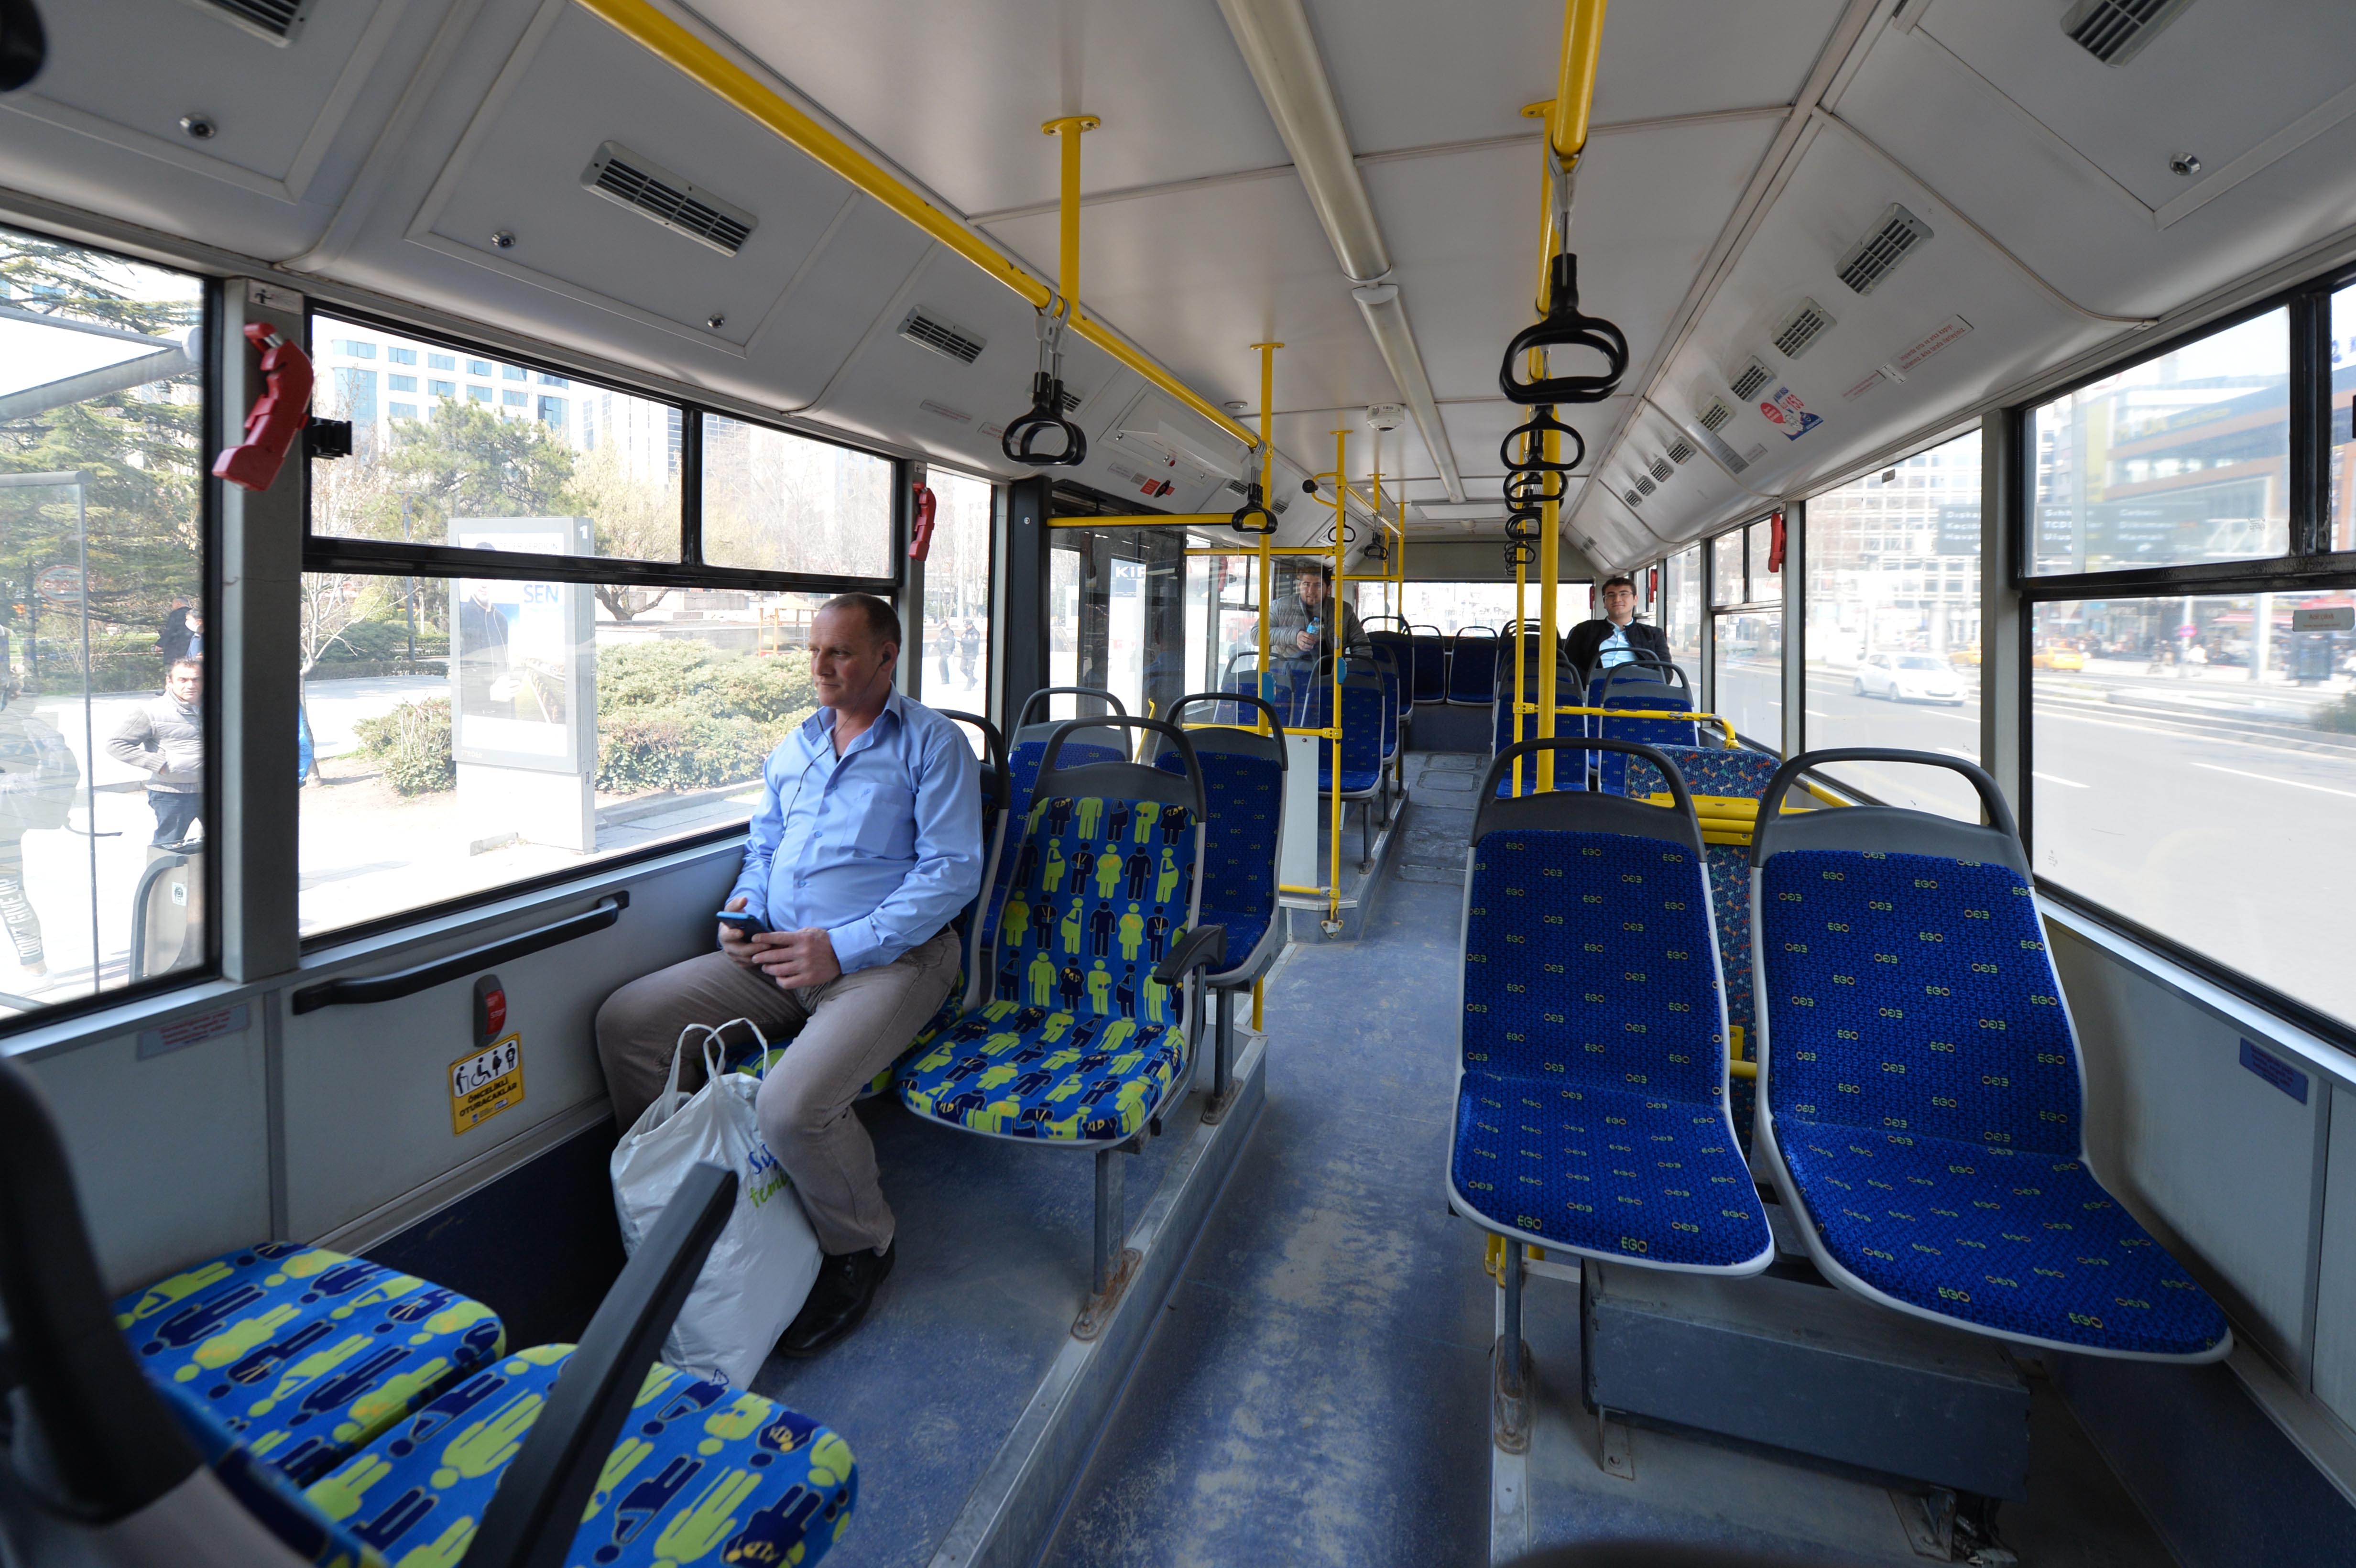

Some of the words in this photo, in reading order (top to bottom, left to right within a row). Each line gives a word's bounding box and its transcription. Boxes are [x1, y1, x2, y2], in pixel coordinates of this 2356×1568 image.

[579, 525, 588, 539] 1
[523, 584, 558, 603] SEN
[1505, 842, 1525, 851] EGO
[1582, 848, 1602, 857] EGO
[1863, 851, 1886, 860] EGO
[1662, 854, 1683, 863] EGO
[1542, 868, 1562, 877] EGO
[1822, 871, 1845, 882] EGO
[1621, 874, 1642, 883] EGO
[1914, 879, 1938, 889] EGO
[0, 878, 19, 896] UP
[1506, 888, 1525, 897] EGO
[1583, 895, 1603, 904] EGO
[1778, 893, 1802, 902] EGO
[1, 893, 33, 924] GIVE
[1664, 902, 1686, 911] EGO
[1868, 901, 1893, 911] EGO
[1543, 915, 1563, 925] EGO
[1963, 909, 1990, 920] EGO
[1623, 922, 1644, 932] EGO
[1827, 922, 1850, 933] EGO
[1506, 935, 1525, 944] EGO
[1919, 932, 1944, 943] EGO
[1584, 943, 1604, 953] EGO
[1784, 943, 1808, 953] EGO
[2020, 939, 2045, 952] EGO
[1468, 954, 1487, 963] EGO
[1667, 951, 1689, 960] EGO
[1874, 953, 1898, 964] EGO
[1544, 963, 1564, 973] EGO
[1971, 963, 1998, 974] EGO
[1624, 972, 1646, 981] EGO
[1832, 975, 1855, 986] EGO
[1506, 983, 1526, 993] EGO
[1925, 986, 1951, 997] EGO
[1584, 993, 1605, 1003] EGO
[1791, 996, 1814, 1007] EGO
[2031, 994, 2058, 1007] EGO
[1467, 1003, 1487, 1013] EGO
[1668, 1002, 1690, 1013] EGO
[1878, 1007, 1903, 1019] EGO
[1543, 1013, 1564, 1024] EGO
[1625, 1023, 1647, 1033] EGO
[1978, 1019, 2006, 1030] EGO
[1506, 1033, 1525, 1042] EGO
[1837, 1029, 1859, 1041] EGO
[1584, 1043, 1605, 1053] EGO
[1930, 1041, 1955, 1053] EGO
[1467, 1052, 1488, 1062] EGO
[1669, 1054, 1690, 1064] EGO
[1796, 1051, 1817, 1062] EGO
[2037, 1054, 2066, 1065] EGO
[1544, 1062, 1565, 1073] EGO
[1881, 1062, 1906, 1074] EGO
[1625, 1073, 1647, 1084] EGO
[1982, 1076, 2009, 1087] EGO
[468, 1077, 508, 1103] ÖNCELİKLİ
[1838, 1083, 1861, 1094] EGO
[459, 1082, 517, 1117] OTURACAKLAR
[1932, 1097, 1957, 1108] EGO
[1795, 1104, 1816, 1114] EGO
[1883, 1117, 1908, 1129] EGO
[1984, 1132, 2010, 1142] EGO
[1517, 1215, 1542, 1230] EGO
[1621, 1236, 1647, 1253] EGO
[1938, 1287, 1971, 1303] EGO
[2068, 1313, 2104, 1329] EGO
